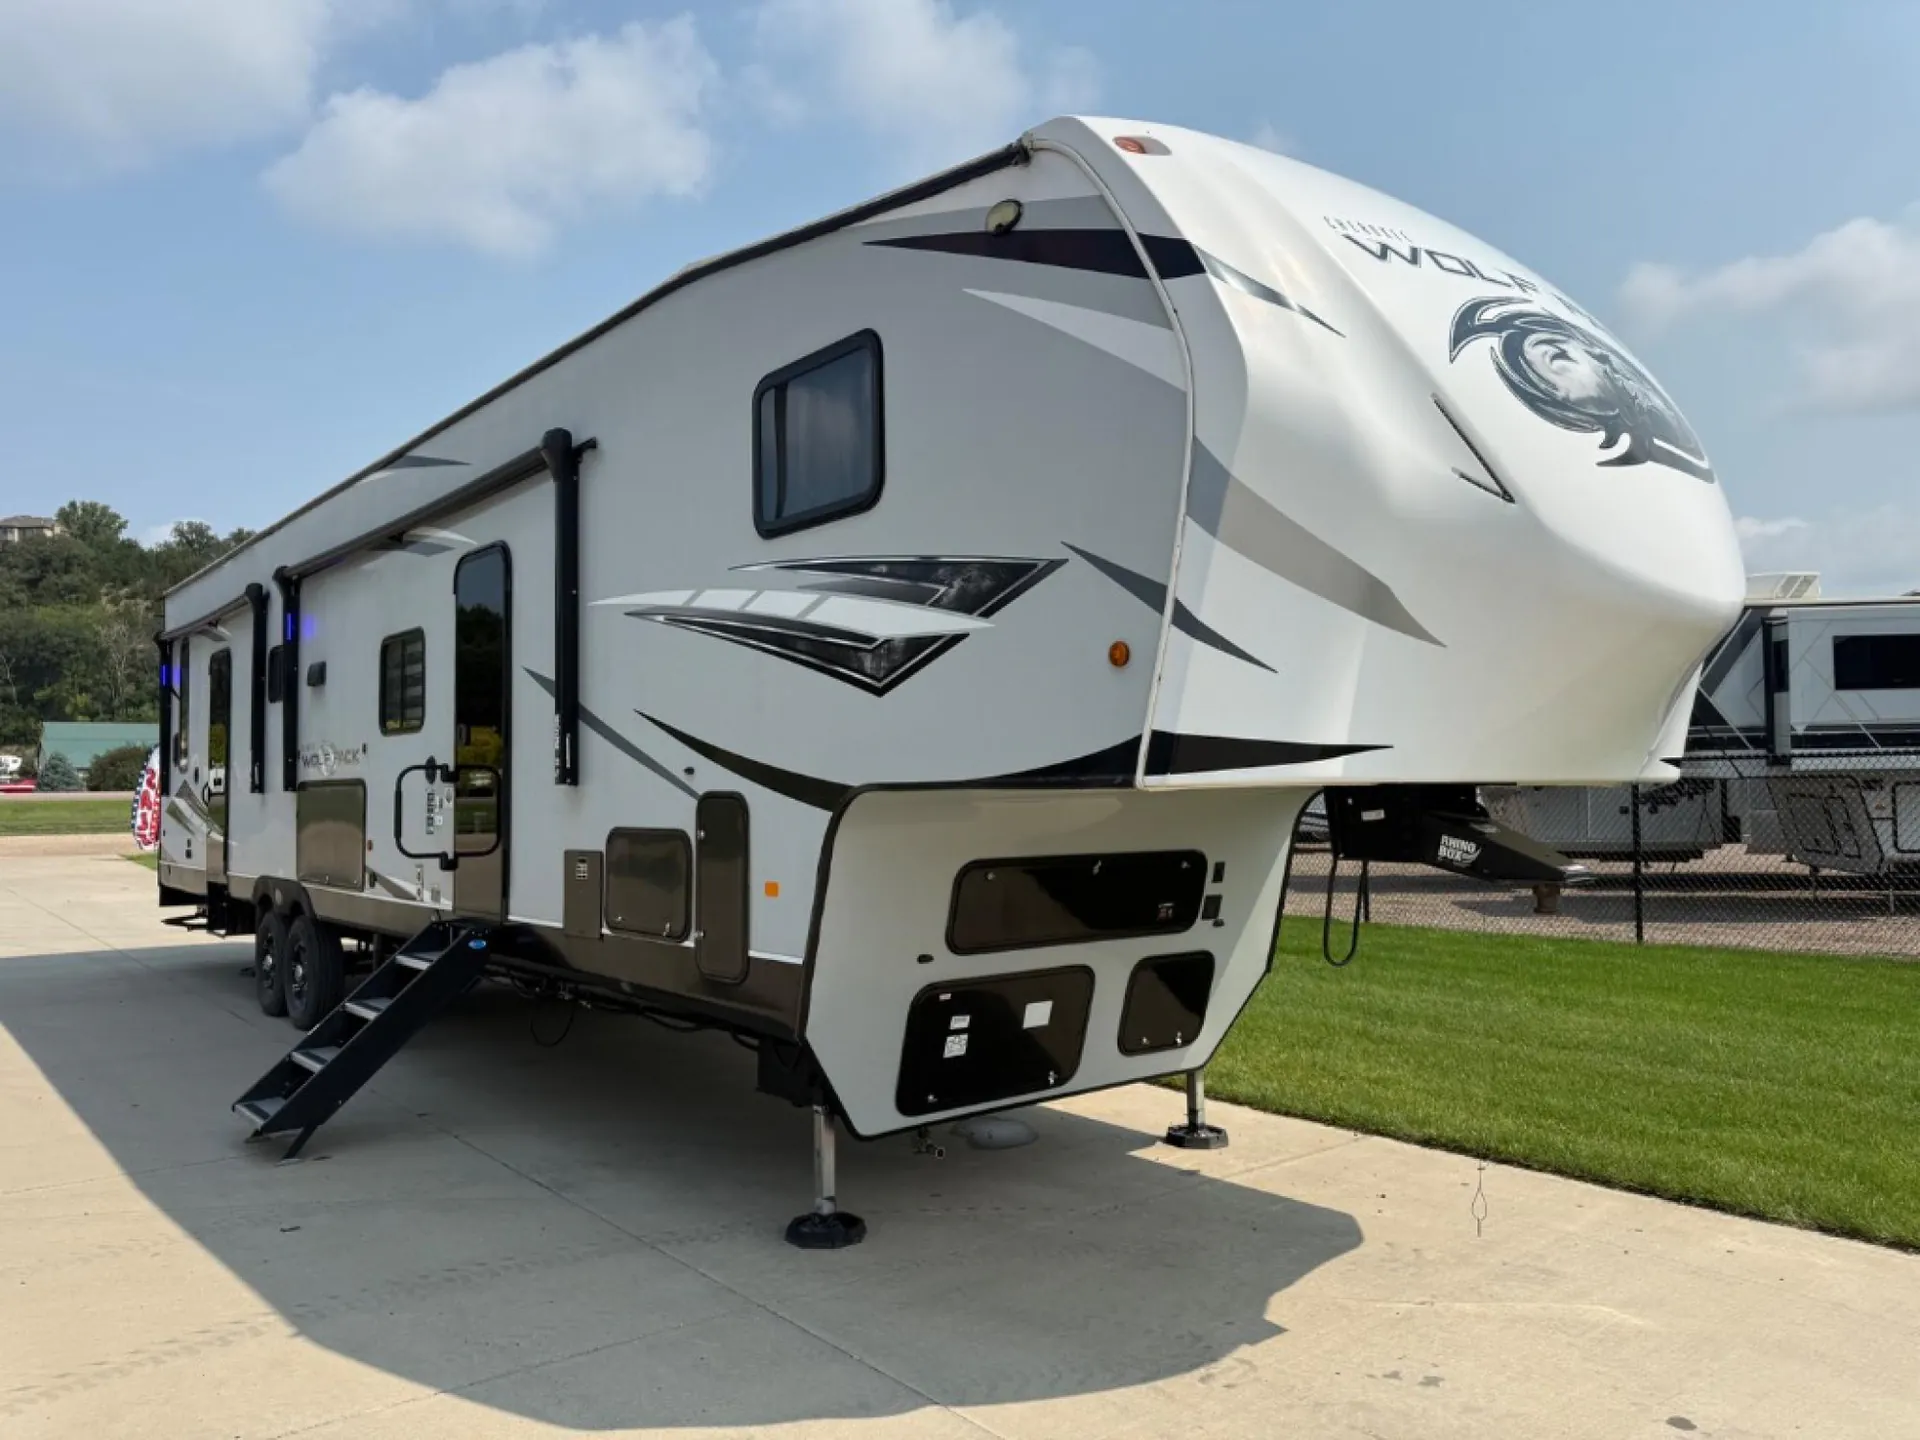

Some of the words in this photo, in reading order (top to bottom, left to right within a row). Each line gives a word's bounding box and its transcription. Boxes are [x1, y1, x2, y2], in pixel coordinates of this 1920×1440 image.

[1342, 234, 1540, 294] WOLF
[1438, 844, 1463, 861] BOX
[1440, 834, 1477, 854] RHINO
